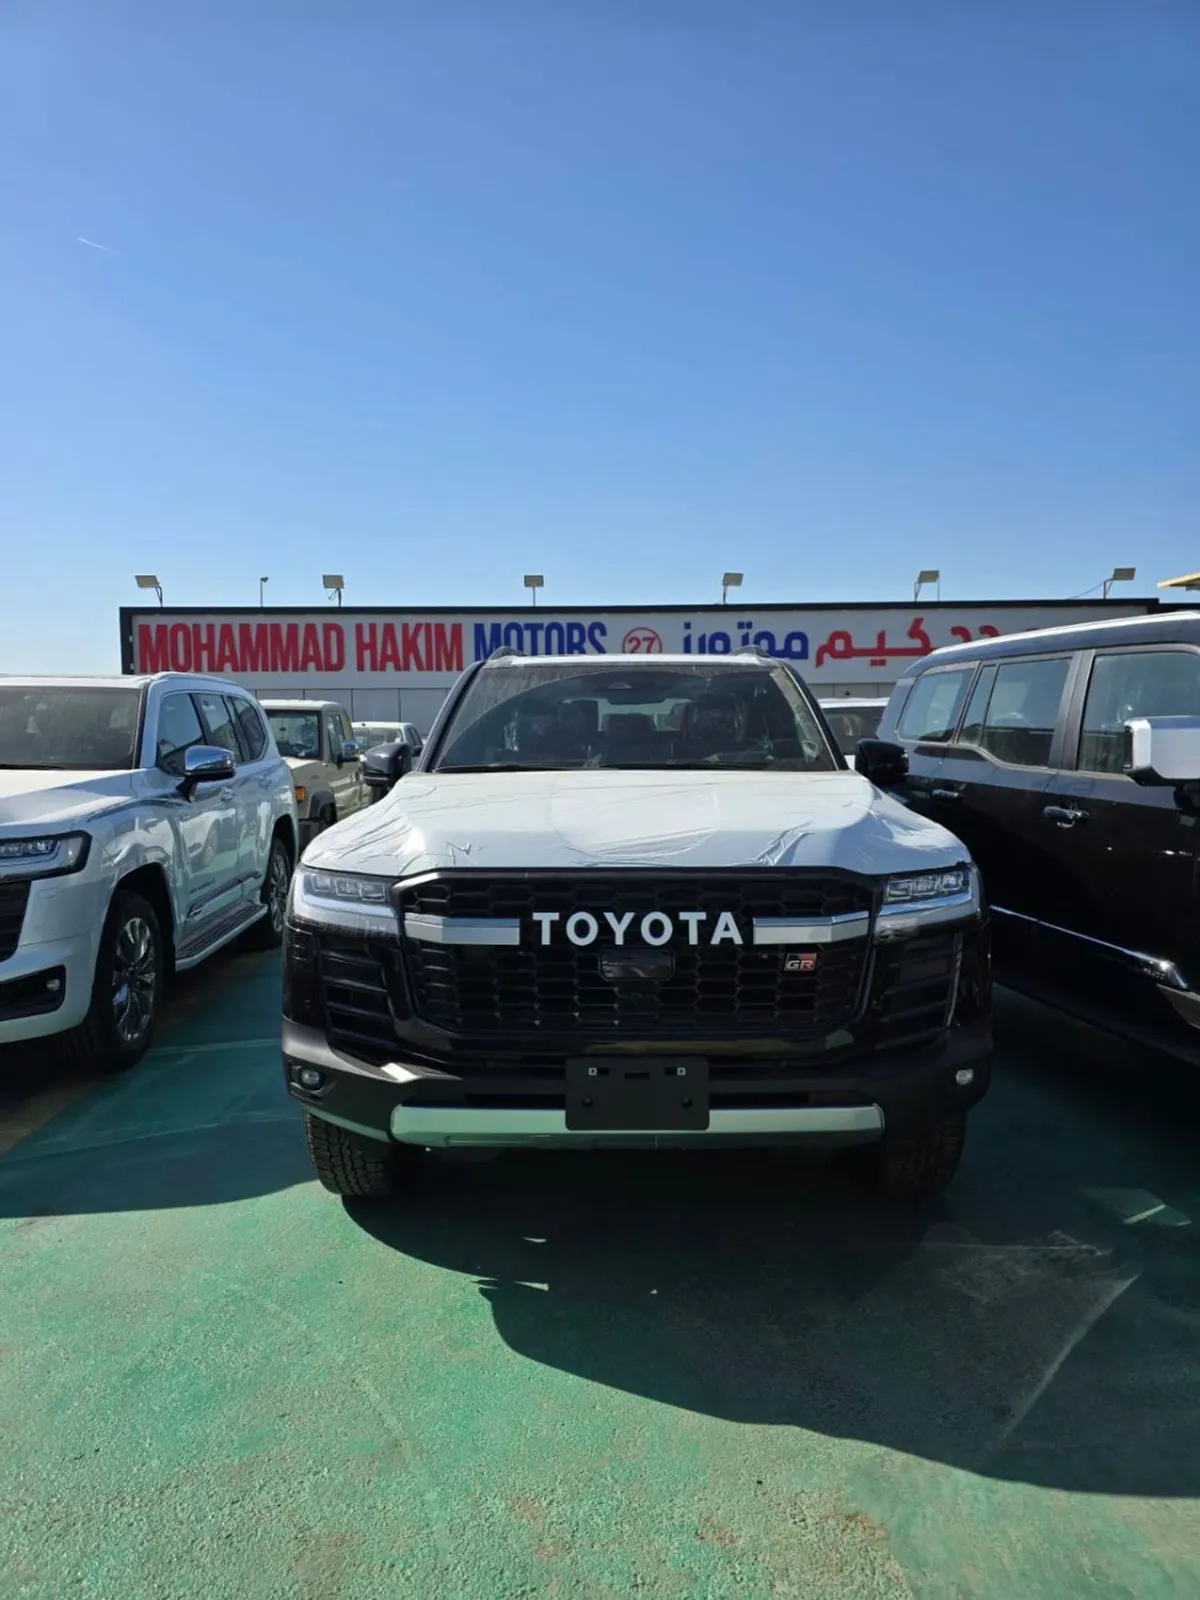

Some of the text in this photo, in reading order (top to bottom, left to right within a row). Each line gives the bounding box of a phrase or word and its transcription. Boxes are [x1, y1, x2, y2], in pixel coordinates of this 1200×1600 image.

[137, 621, 656, 673] MOHAMMAD HAKIM MOTORS 27
[532, 911, 744, 946] TOYOTA
[785, 959, 815, 971] GR
